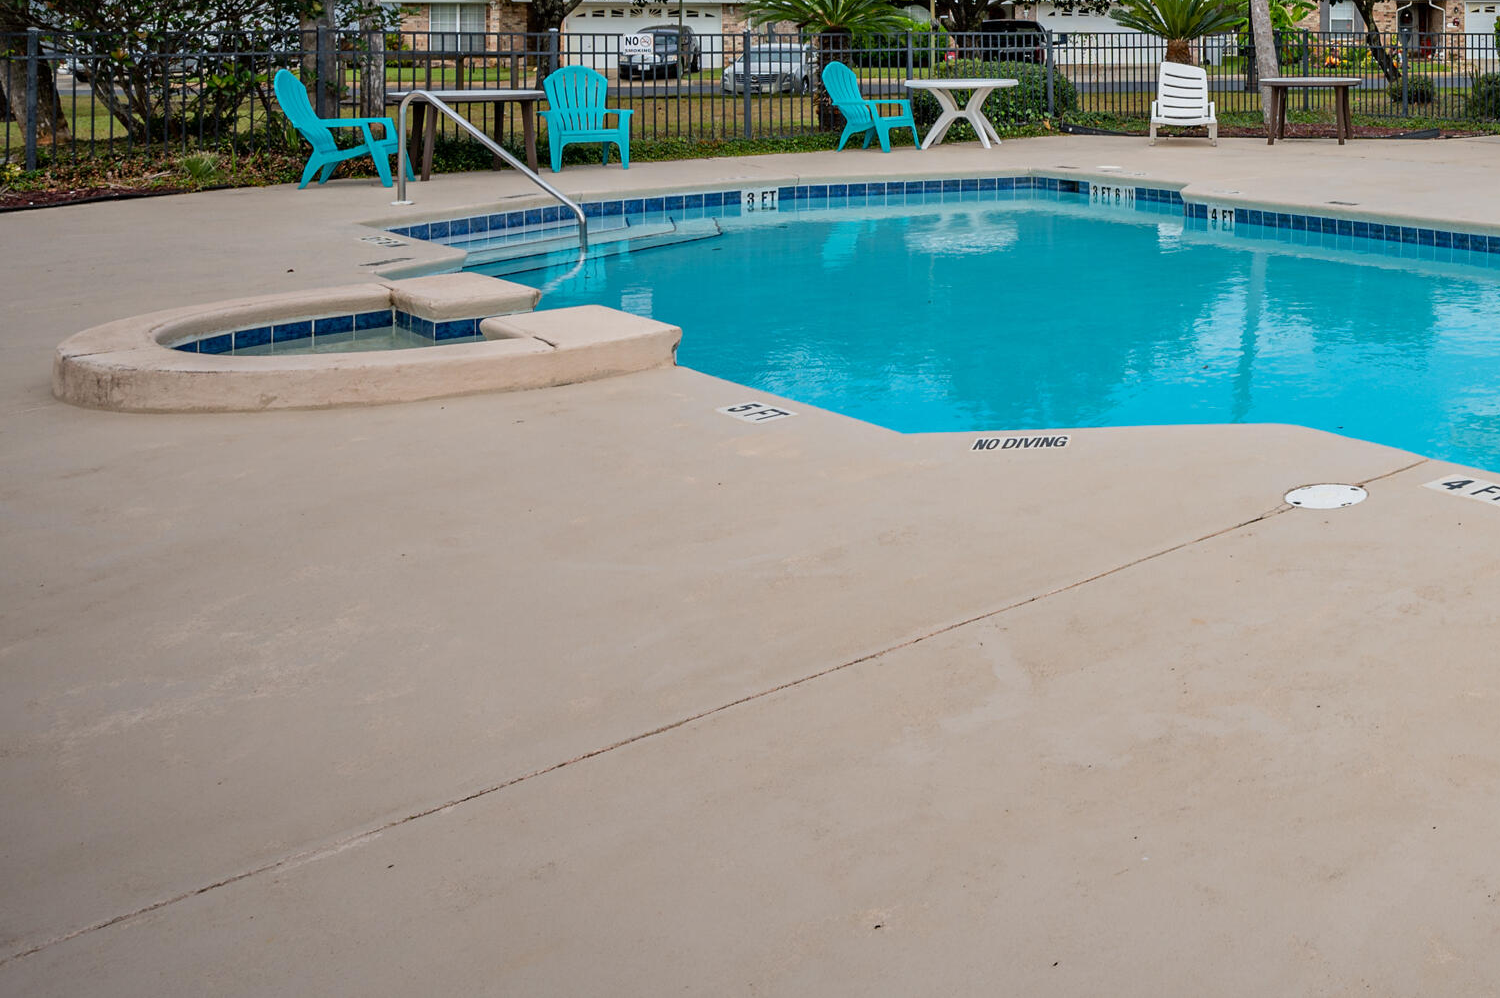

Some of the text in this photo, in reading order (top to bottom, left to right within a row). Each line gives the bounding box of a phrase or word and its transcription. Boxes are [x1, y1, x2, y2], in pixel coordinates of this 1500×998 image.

[625, 36, 639, 46] NO
[747, 190, 777, 204] 3 FT
[1092, 185, 1134, 201] 3 FT 6 IN
[1211, 208, 1233, 222] 4 FT
[727, 403, 790, 421] 5 FT
[972, 436, 1068, 450] NO DIVING
[1441, 479, 1475, 490] 4
